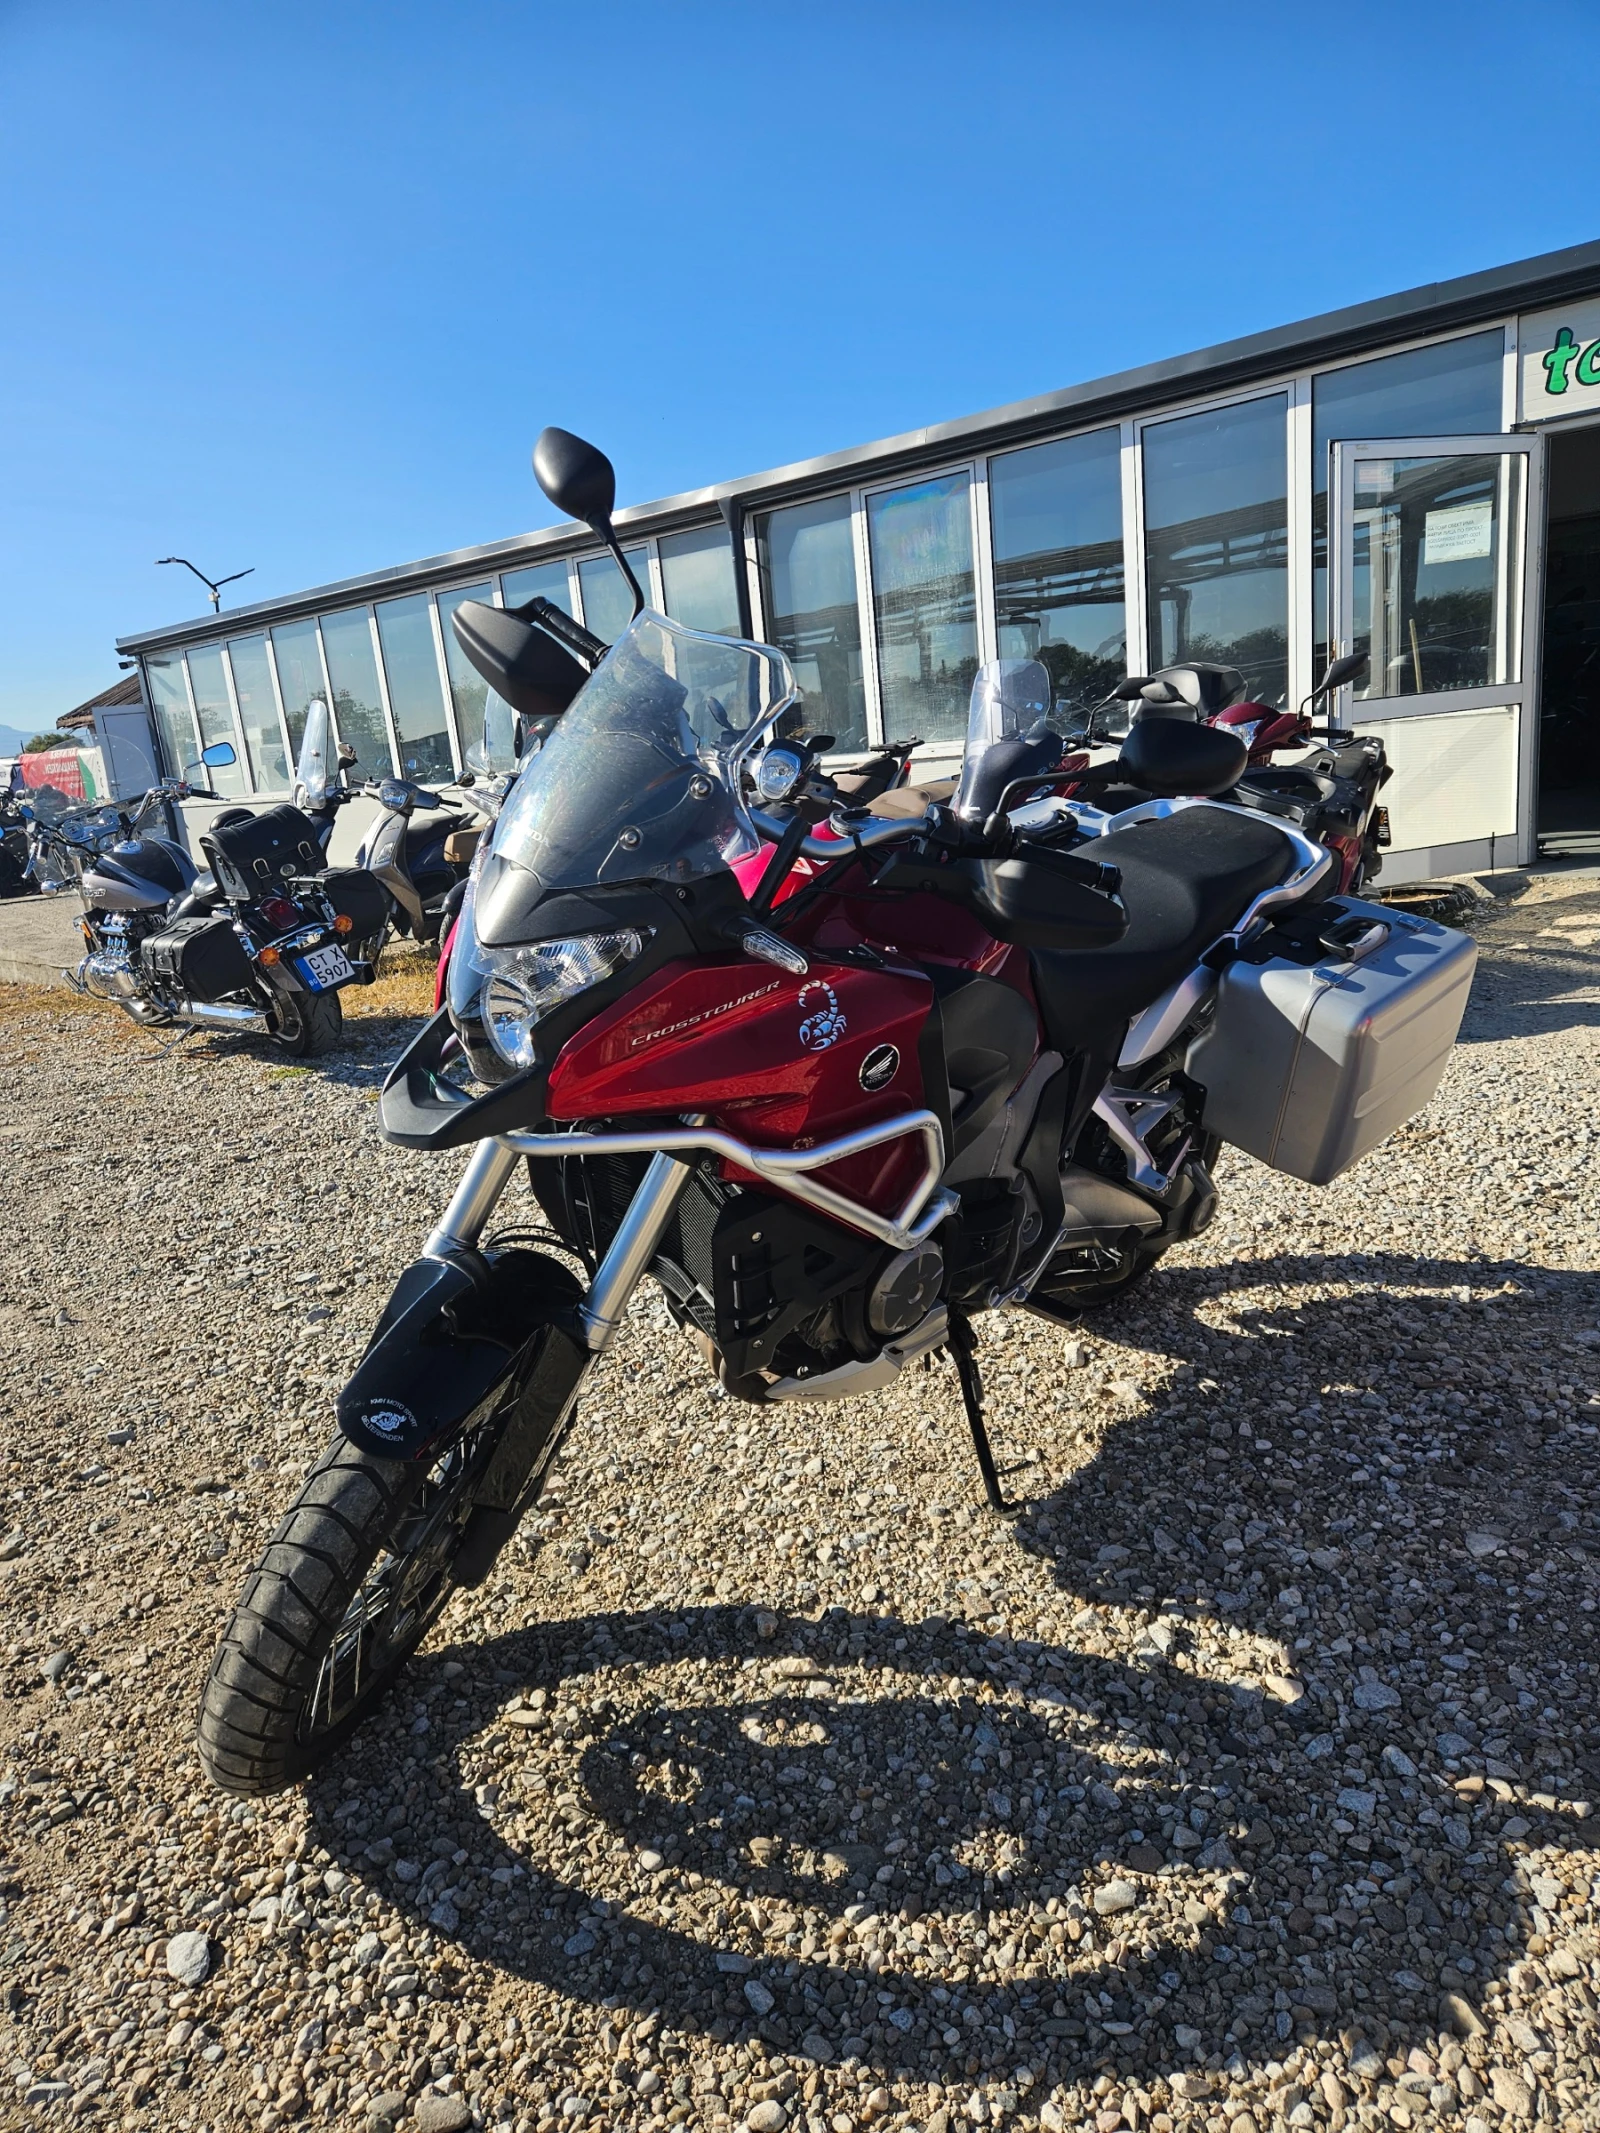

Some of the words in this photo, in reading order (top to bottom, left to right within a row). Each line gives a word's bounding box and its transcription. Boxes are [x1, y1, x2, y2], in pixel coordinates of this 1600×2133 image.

[308, 953, 328, 970] CT
[329, 947, 343, 961] X
[308, 978, 318, 987] BG
[316, 960, 348, 984] 5907
[631, 980, 780, 1046] CROSSTOURER
[865, 1071, 893, 1085] HONDA
[386, 1398, 404, 1410] MOTO
[403, 1407, 418, 1428] SPORT
